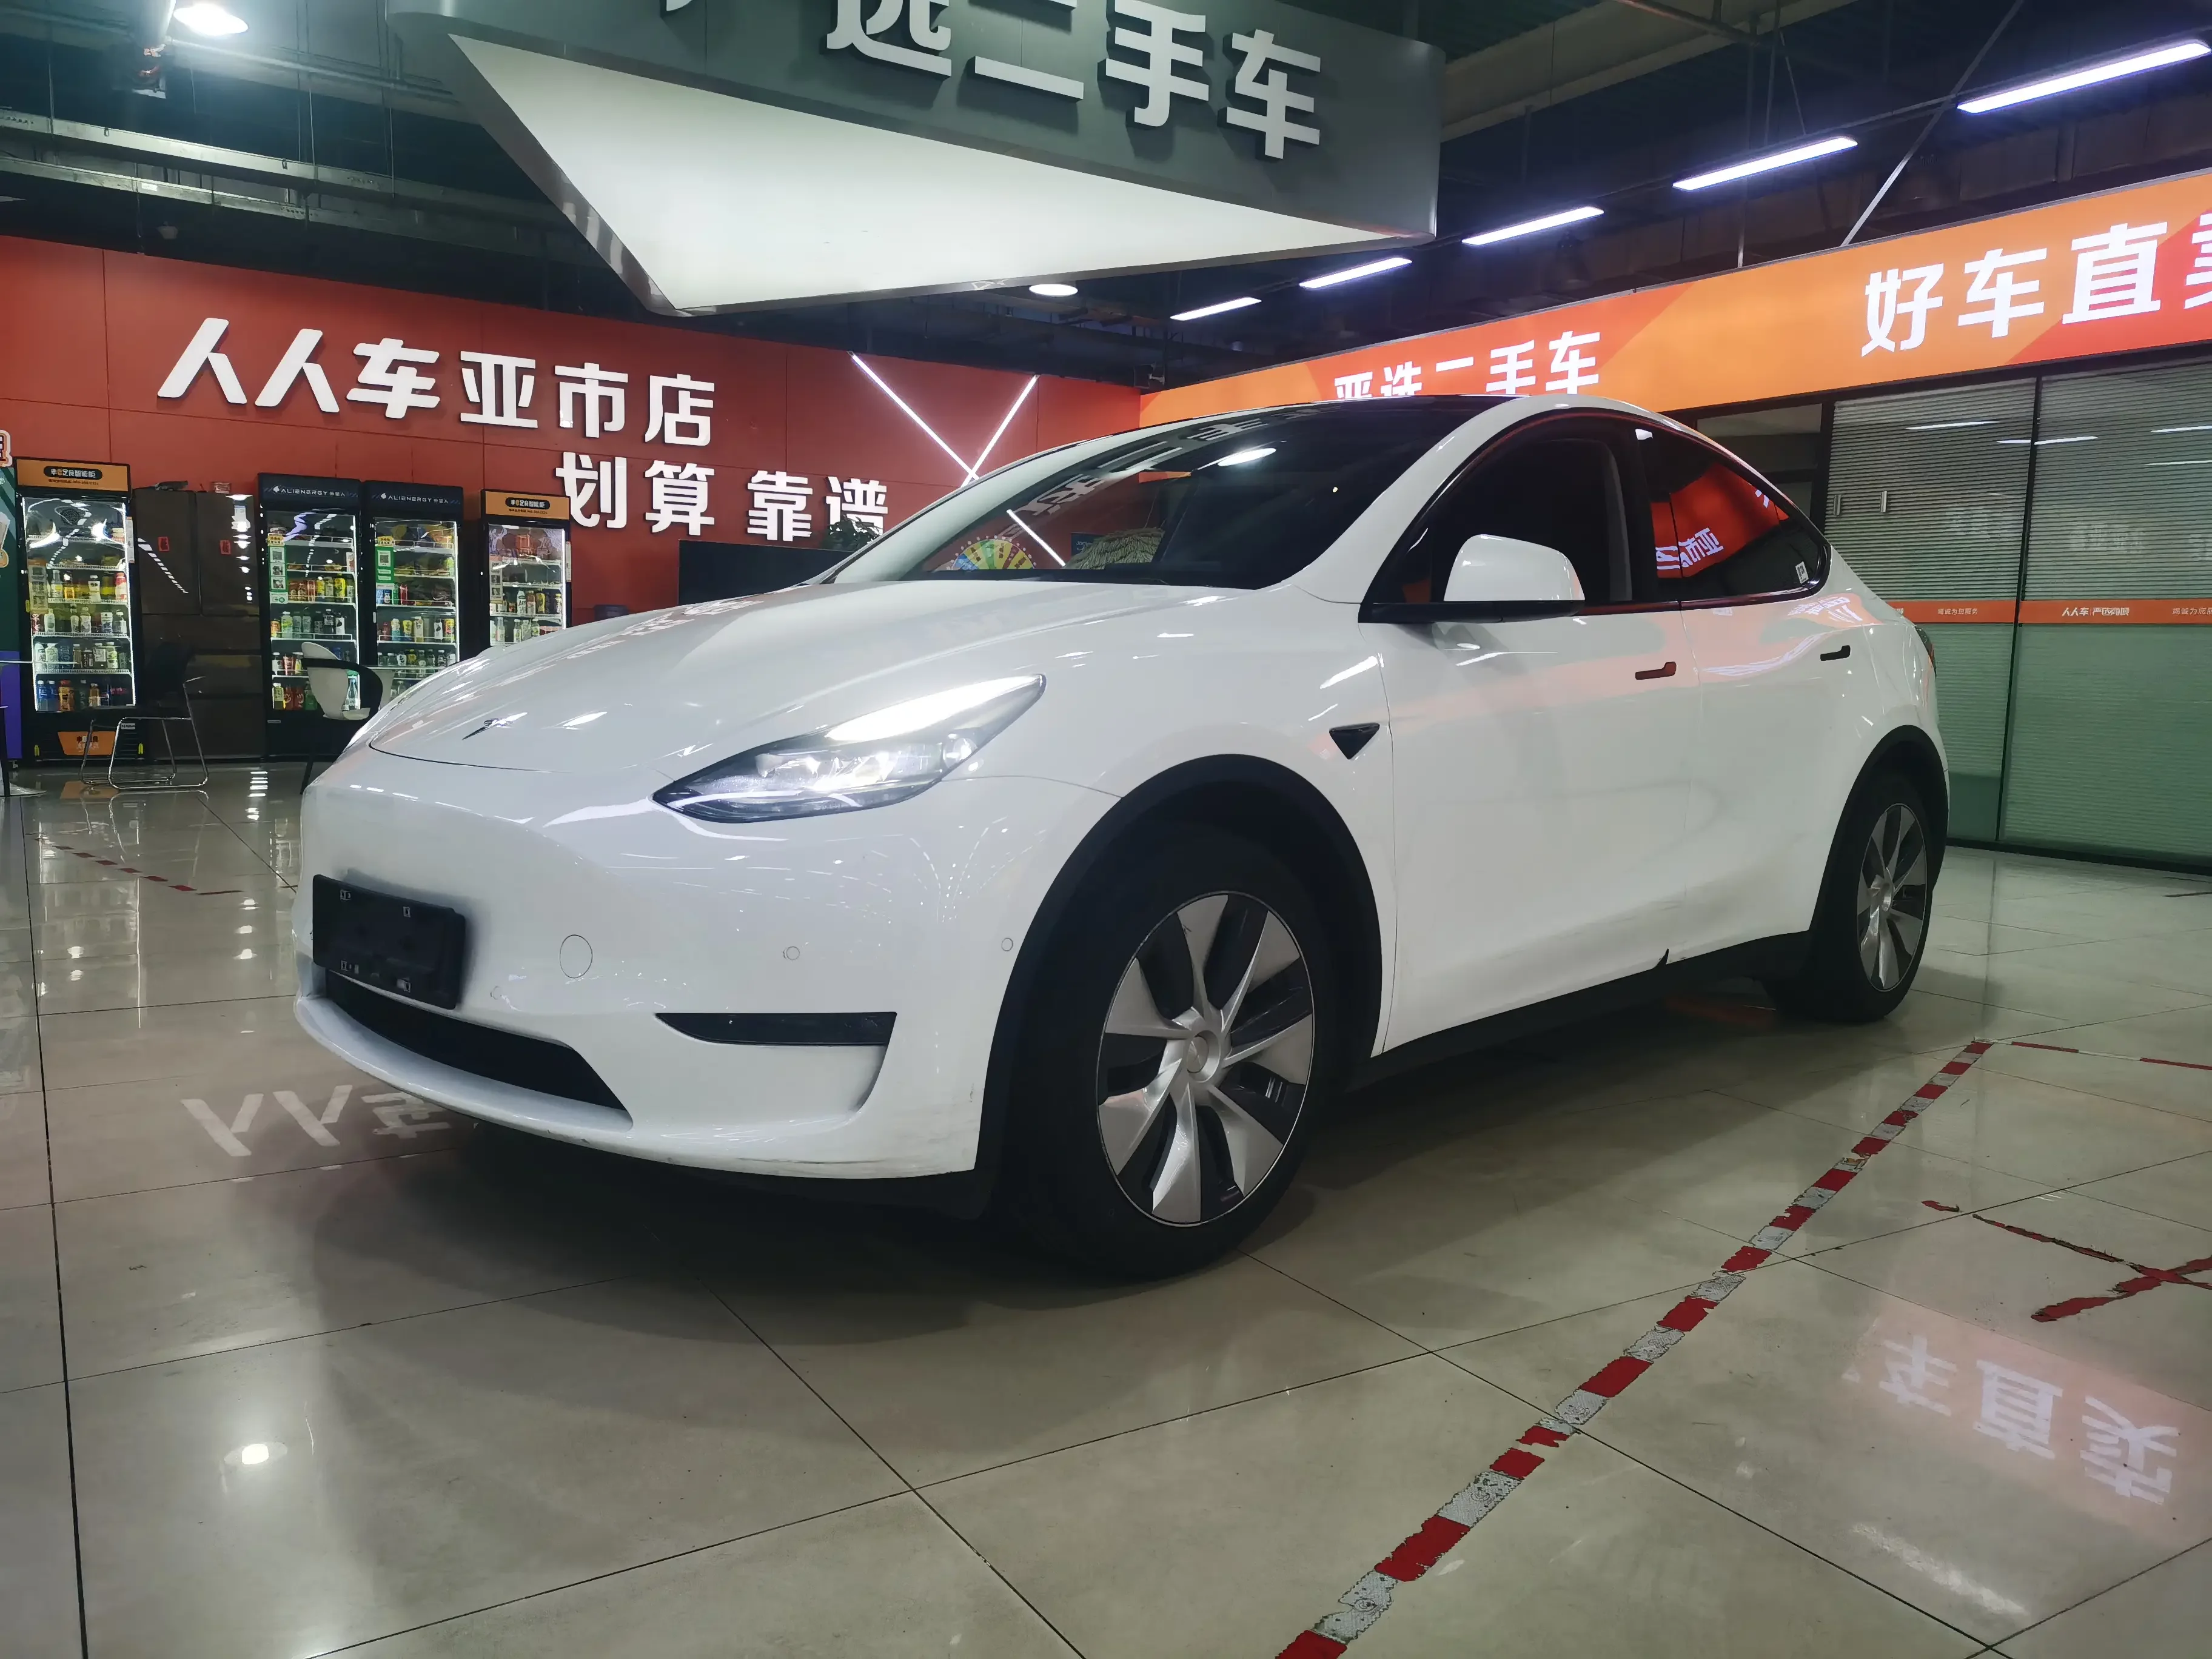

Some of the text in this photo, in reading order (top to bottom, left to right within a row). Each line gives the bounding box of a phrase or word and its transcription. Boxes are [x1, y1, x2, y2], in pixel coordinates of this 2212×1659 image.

[666, 0, 1321, 159] 选二手车
[555, 452, 888, 542] 划算 靠谱
[2062, 607, 2090, 616] 人人车
